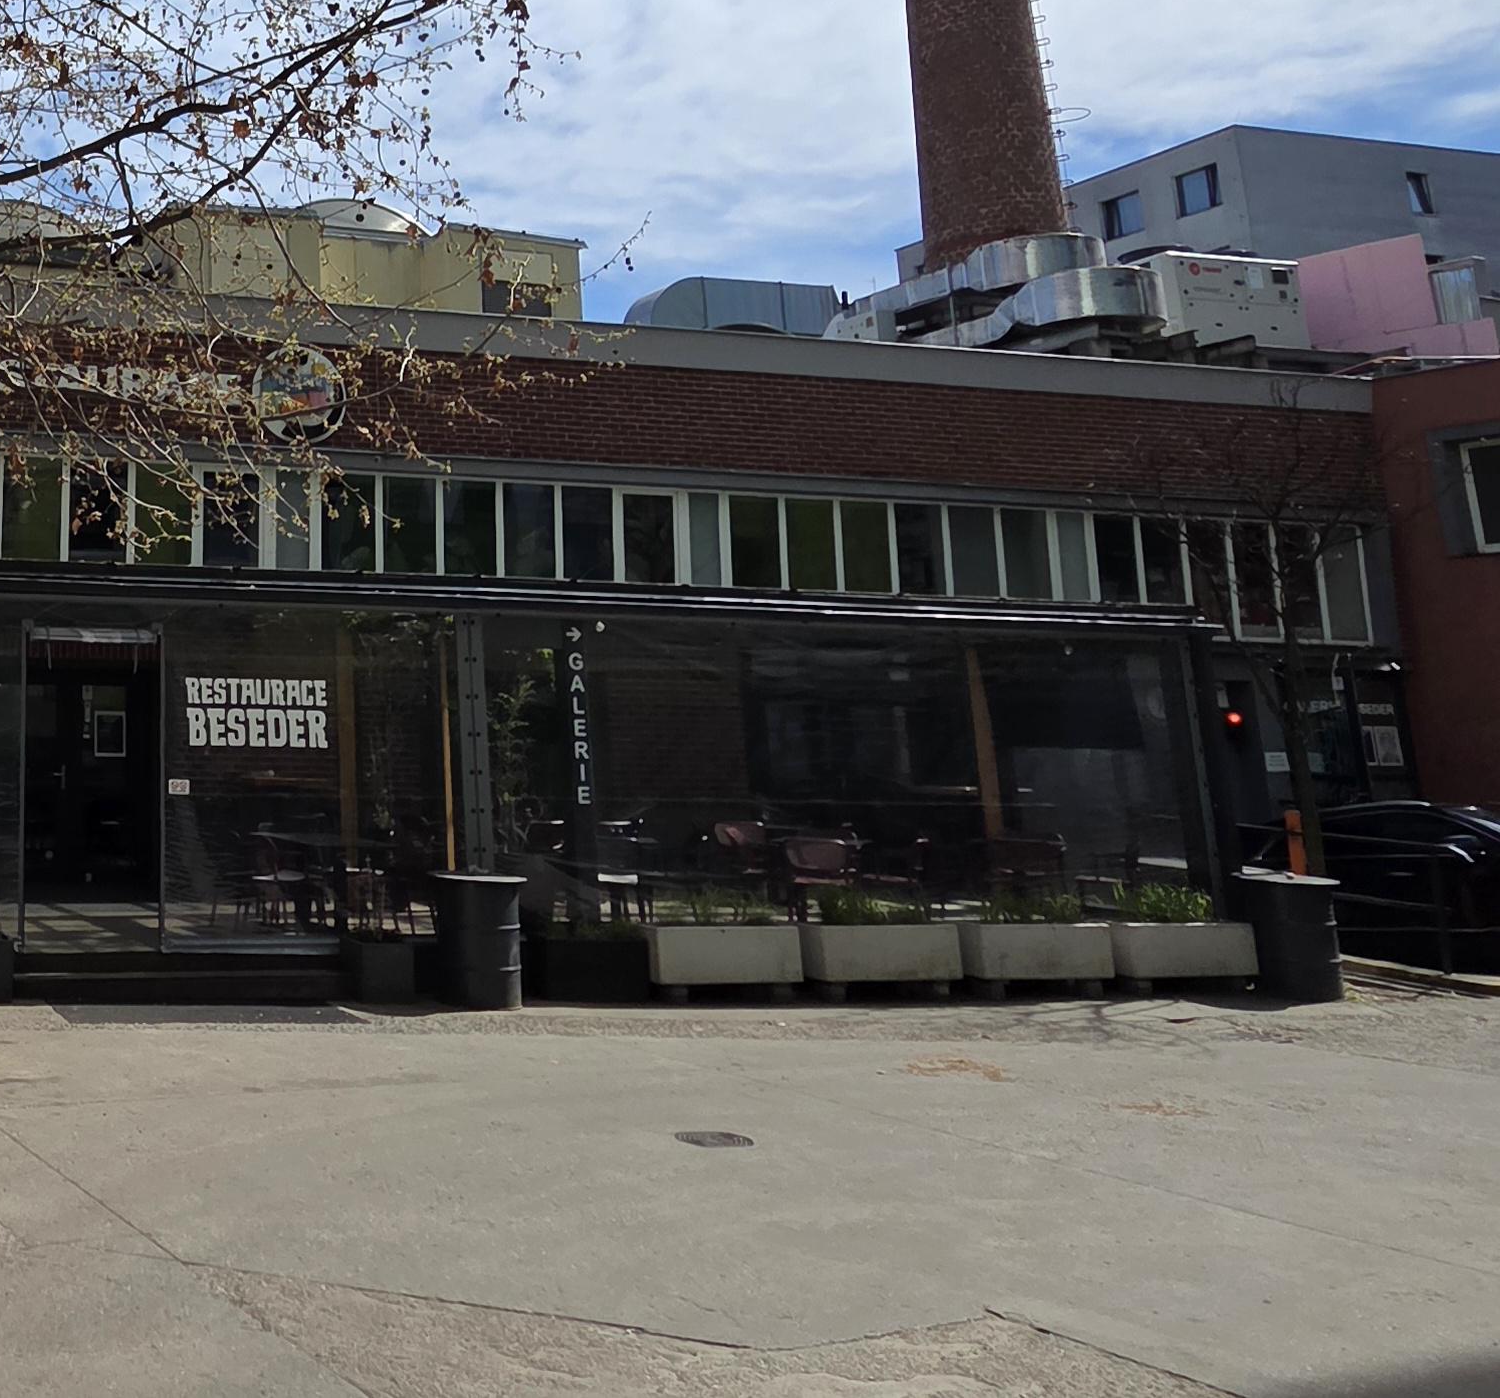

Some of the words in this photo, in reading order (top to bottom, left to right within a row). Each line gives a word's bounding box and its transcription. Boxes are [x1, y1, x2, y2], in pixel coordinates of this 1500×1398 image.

[184, 677, 328, 707] RESTAURACE
[186, 707, 329, 749] BESEDER
[568, 652, 592, 805] GALERIE
